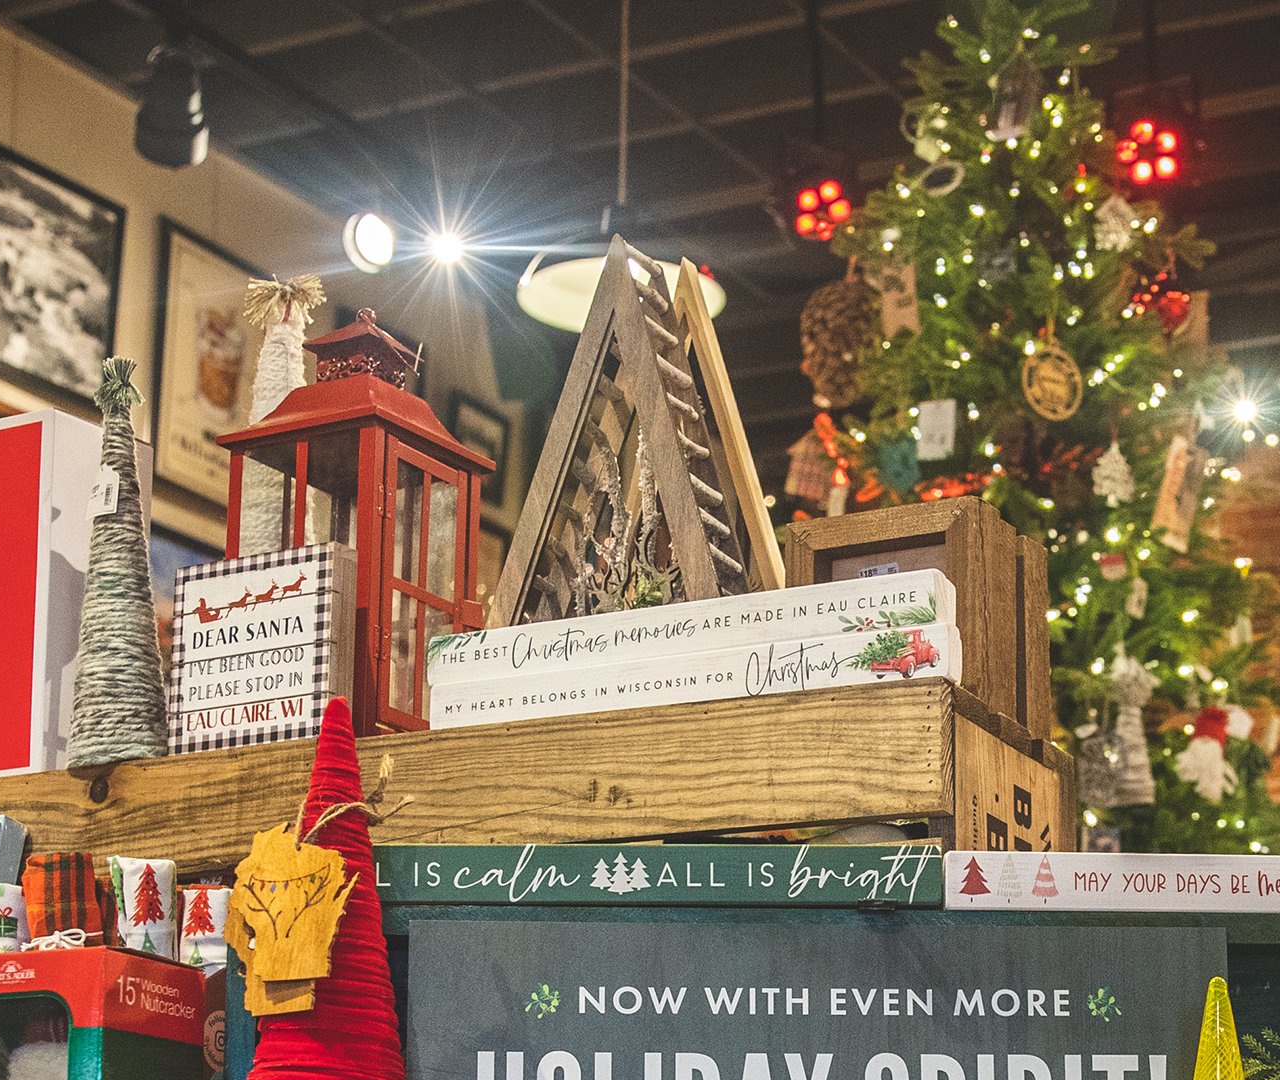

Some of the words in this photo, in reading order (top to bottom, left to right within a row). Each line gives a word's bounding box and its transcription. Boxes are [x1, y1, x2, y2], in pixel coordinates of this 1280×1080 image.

[192, 626, 239, 650] DEAR
[246, 616, 304, 641] SANTA
[442, 652, 466, 665] THE
[474, 646, 508, 661] BEST
[511, 627, 609, 669] Christmas
[614, 618, 698, 646] memories
[702, 615, 731, 630] ARE
[741, 609, 784, 625] MADE
[793, 605, 807, 617] IN
[817, 600, 848, 615] EAU
[857, 591, 917, 609] CLAIRE
[189, 659, 214, 678] I'VE
[220, 654, 255, 673] BEEN
[259, 646, 305, 667] GOOD
[189, 680, 241, 702] PLEASE
[246, 673, 284, 694] STOP
[288, 671, 303, 687] IN
[445, 703, 464, 715] MY
[471, 697, 515, 712] HEART
[522, 689, 587, 705] BELONGS
[595, 686, 608, 697] IN
[617, 675, 698, 694] WISCONSIN
[706, 671, 734, 684] FOR
[745, 642, 861, 696] Christmas
[187, 709, 219, 732] EAU
[221, 701, 277, 727] CLAIRE,
[281, 698, 304, 718] WI
[414, 862, 441, 887] IS
[453, 843, 580, 903] calm
[657, 862, 725, 887] ALL
[748, 862, 775, 887] IS
[787, 844, 942, 905] bright
[1074, 871, 1112, 893] MAY
[1122, 872, 1167, 894] YOUR
[1176, 873, 1222, 895] DAYS
[1231, 874, 1250, 895] BE
[140, 979, 180, 998] Wooden
[578, 986, 687, 1016] NOW
[690, 986, 810, 1017] WITH
[830, 988, 933, 1017] EVEN
[953, 988, 1071, 1018] MORE
[141, 993, 197, 1019] Nutcracker
